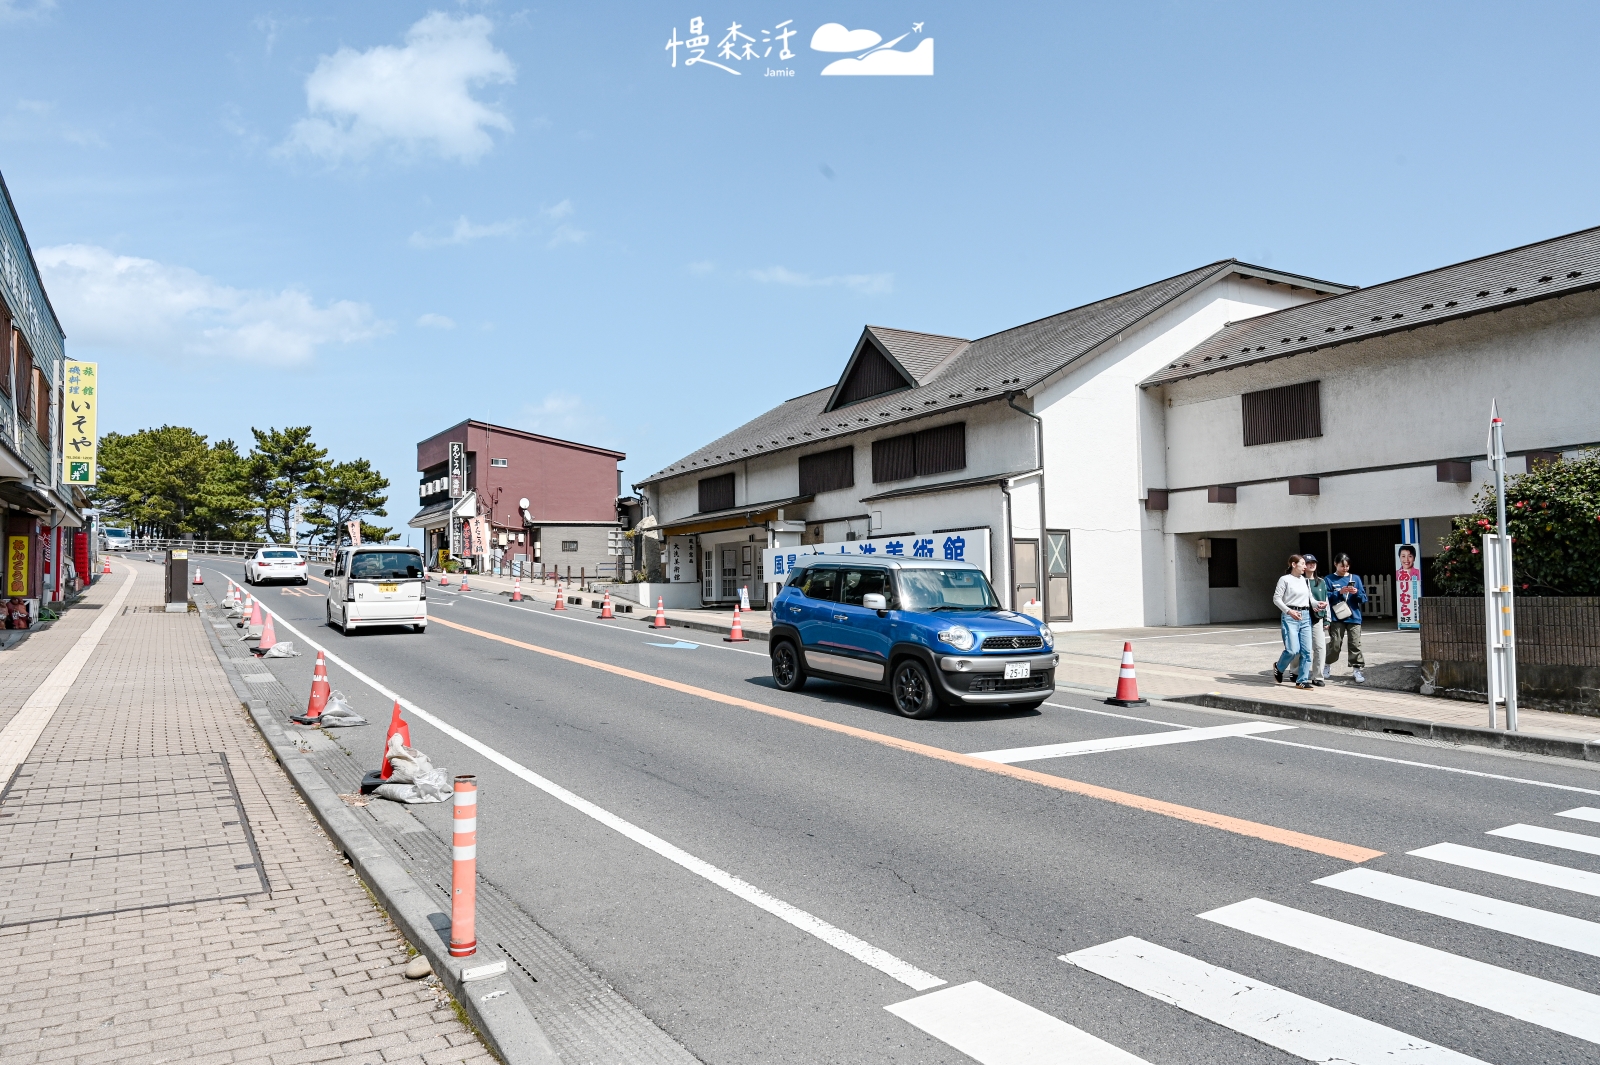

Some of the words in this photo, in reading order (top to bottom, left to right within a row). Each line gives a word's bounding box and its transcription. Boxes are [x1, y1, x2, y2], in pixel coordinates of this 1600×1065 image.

[68, 365, 81, 395] 磯料理
[82, 366, 94, 396] 旅館
[69, 400, 92, 452] いそや
[1399, 570, 1411, 616] ありむら
[1010, 668, 1028, 678] 25-13
